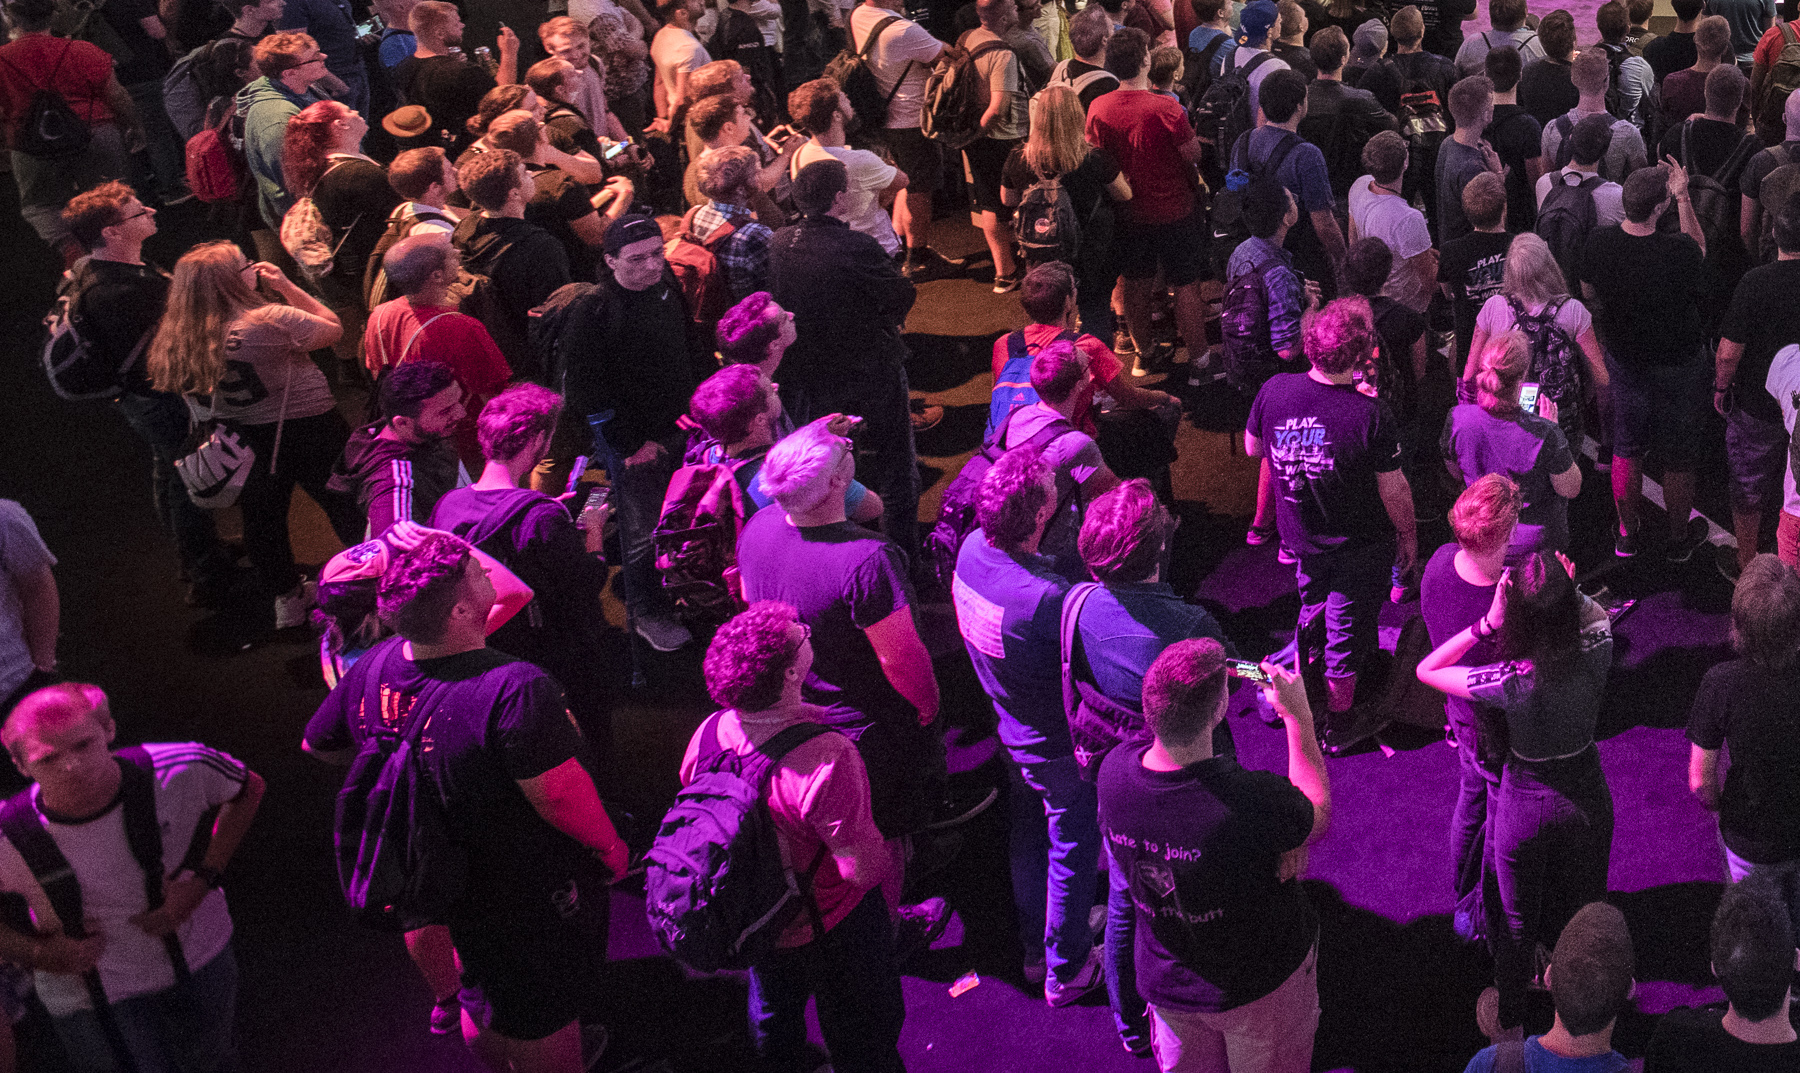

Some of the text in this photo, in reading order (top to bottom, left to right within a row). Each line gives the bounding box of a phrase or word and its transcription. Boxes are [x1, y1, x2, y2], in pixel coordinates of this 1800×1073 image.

[1477, 253, 1502, 268] PLAY
[1285, 417, 1318, 430] PLAY
[1274, 428, 1326, 447] YOUR
[1143, 839, 1159, 853] to
[1164, 842, 1201, 862] join?
